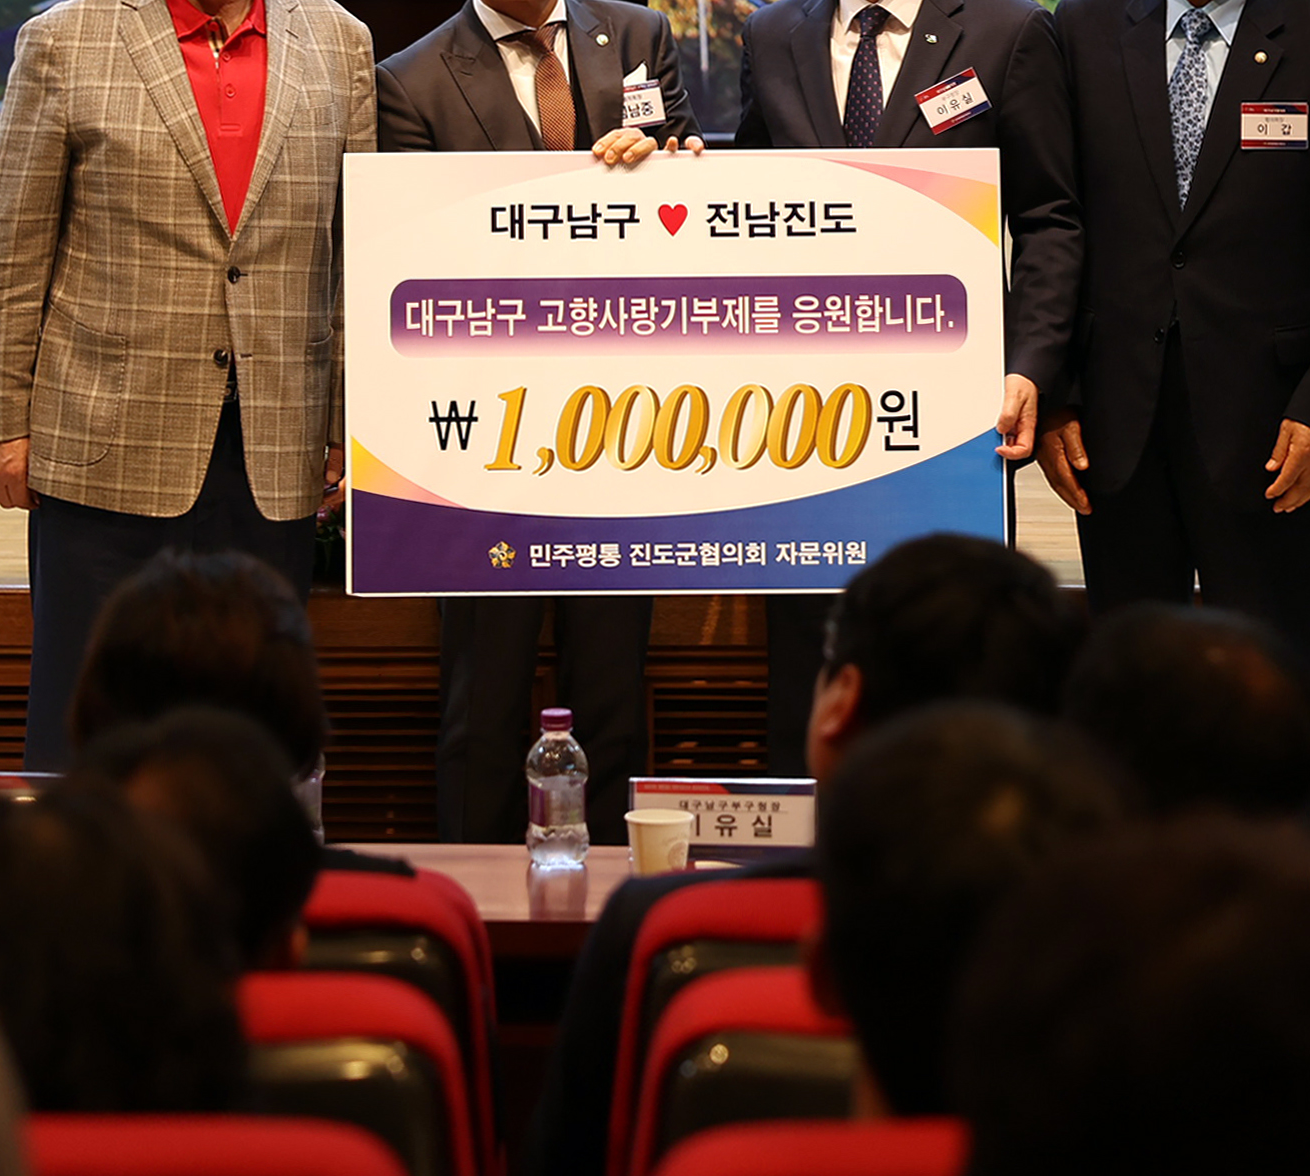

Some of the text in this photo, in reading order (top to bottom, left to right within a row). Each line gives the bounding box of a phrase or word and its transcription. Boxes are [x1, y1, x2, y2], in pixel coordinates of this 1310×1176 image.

[490, 201, 857, 240] 대구남구 전남진도
[405, 293, 955, 337] 대구남구 고향사랑기부제를 응원합니다.
[528, 540, 868, 568] 민주평통 진도군협의회 자문위원
